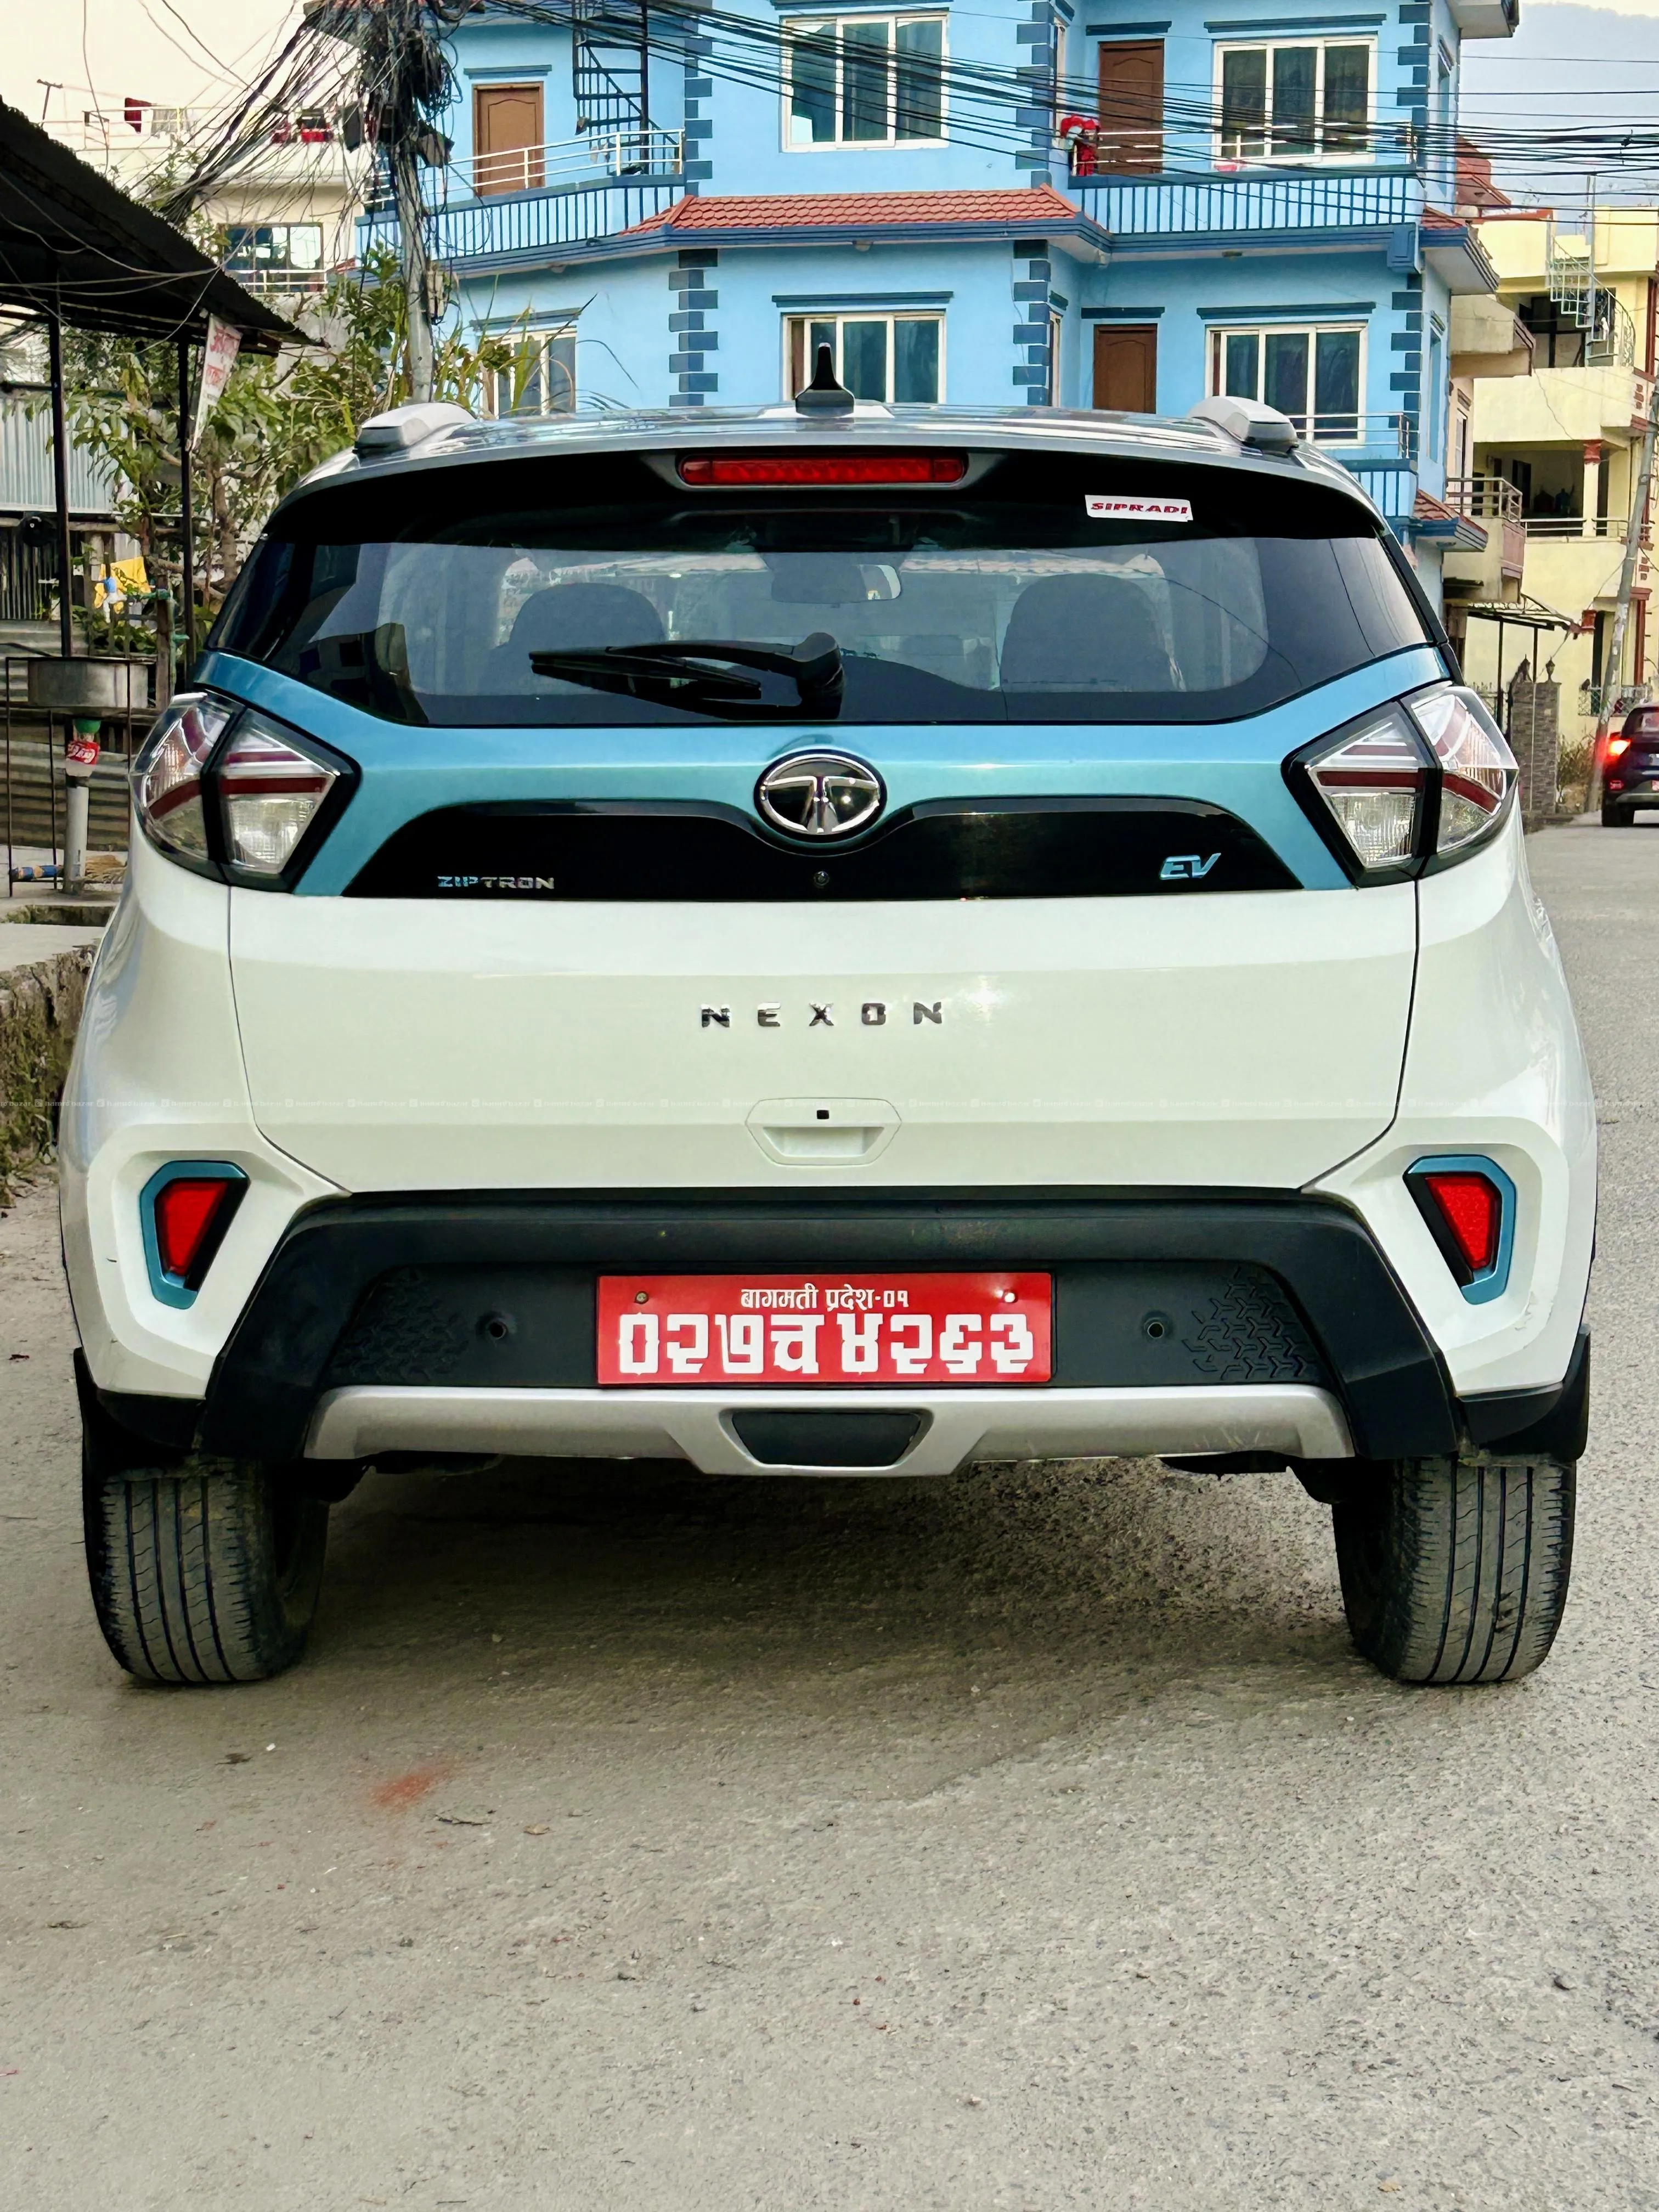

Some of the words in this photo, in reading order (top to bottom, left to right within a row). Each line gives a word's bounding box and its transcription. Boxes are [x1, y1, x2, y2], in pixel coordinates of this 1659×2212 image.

[1090, 503, 1188, 514] SIPRADI
[1159, 853, 1222, 880] EV
[437, 876, 555, 889] ZIPTRON
[701, 1001, 943, 1028] NEXON
[741, 1283, 819, 1310] बागमती
